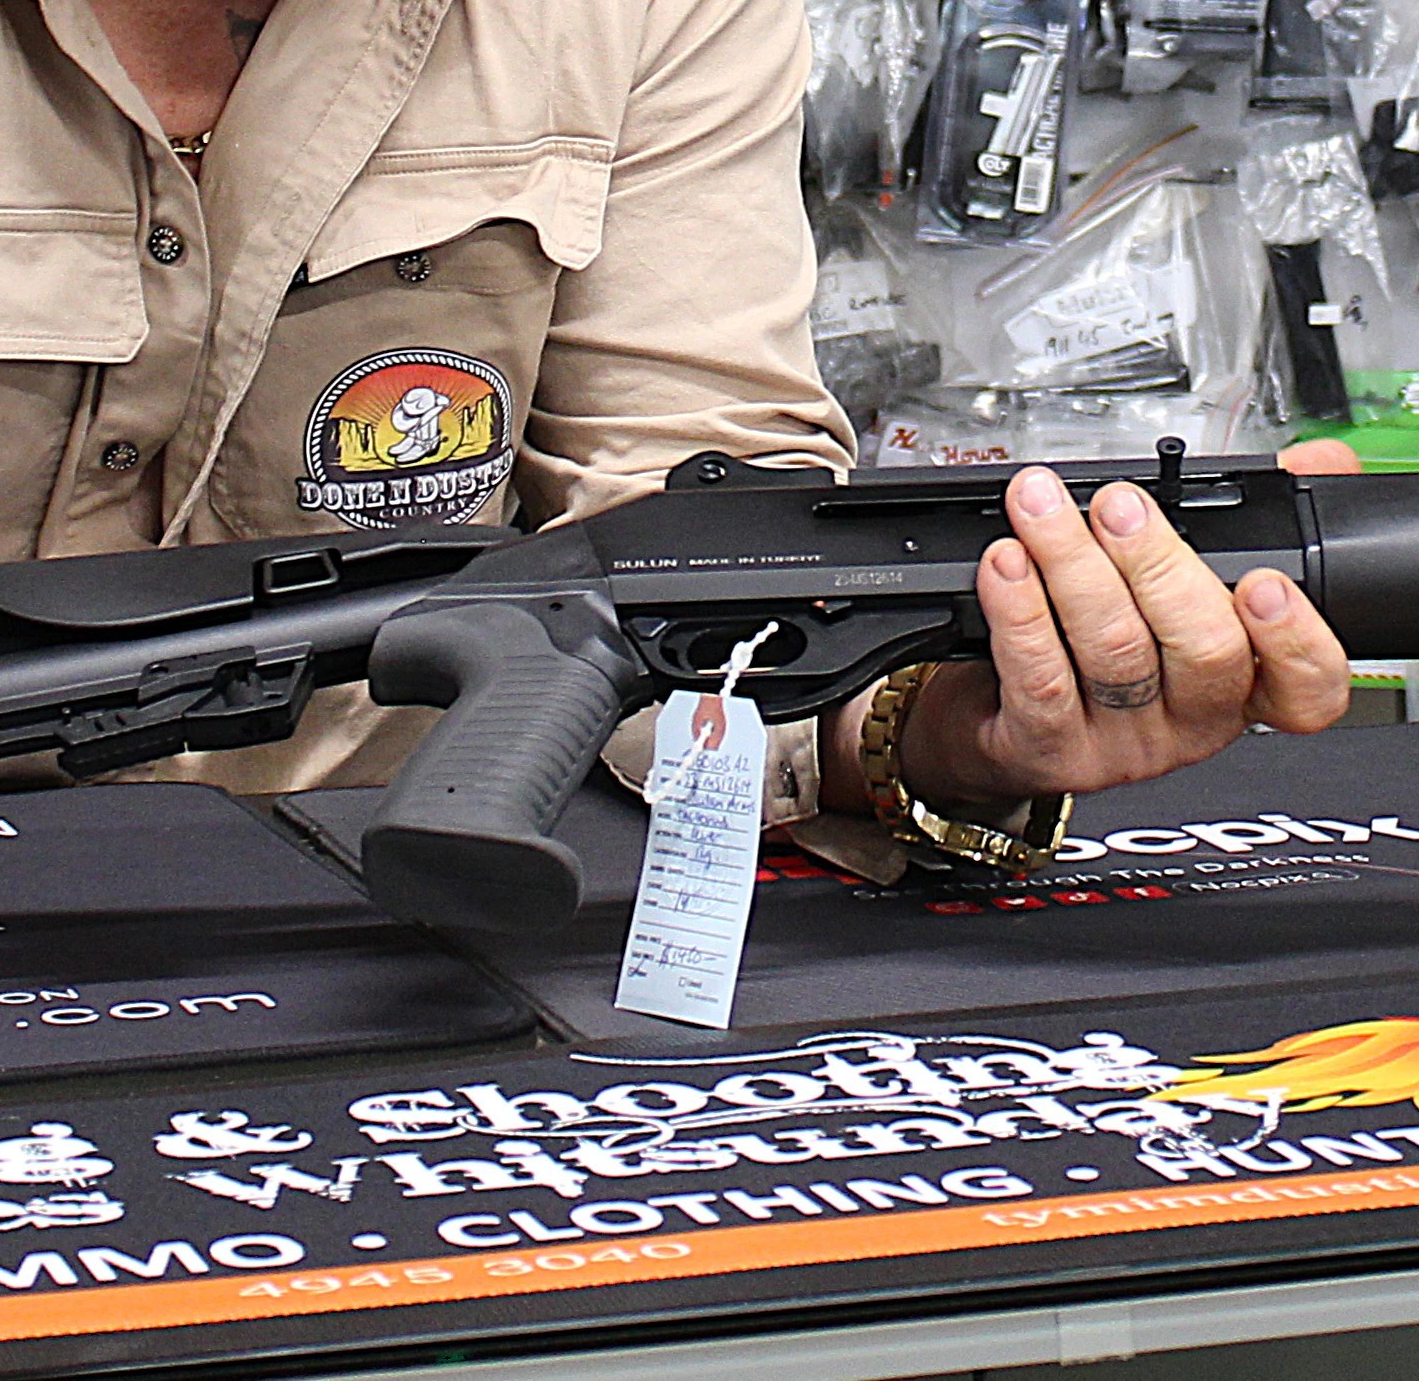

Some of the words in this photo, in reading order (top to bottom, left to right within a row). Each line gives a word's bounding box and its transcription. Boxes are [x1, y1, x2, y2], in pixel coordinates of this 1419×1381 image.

[298, 481, 385, 510] DONE
[379, 497, 468, 519] COUNTRY
[613, 558, 678, 570] SULUN
[1110, 867, 1185, 881] The
[1194, 854, 1370, 874] Darkness
[1189, 873, 1309, 892] Nocpix
[152, 1110, 313, 1160] &
[348, 1031, 1183, 1144] Shooting
[437, 1166, 1034, 1249] CLOTHING
[238, 1267, 455, 1300] 4945
[484, 1242, 693, 1279] 3040
